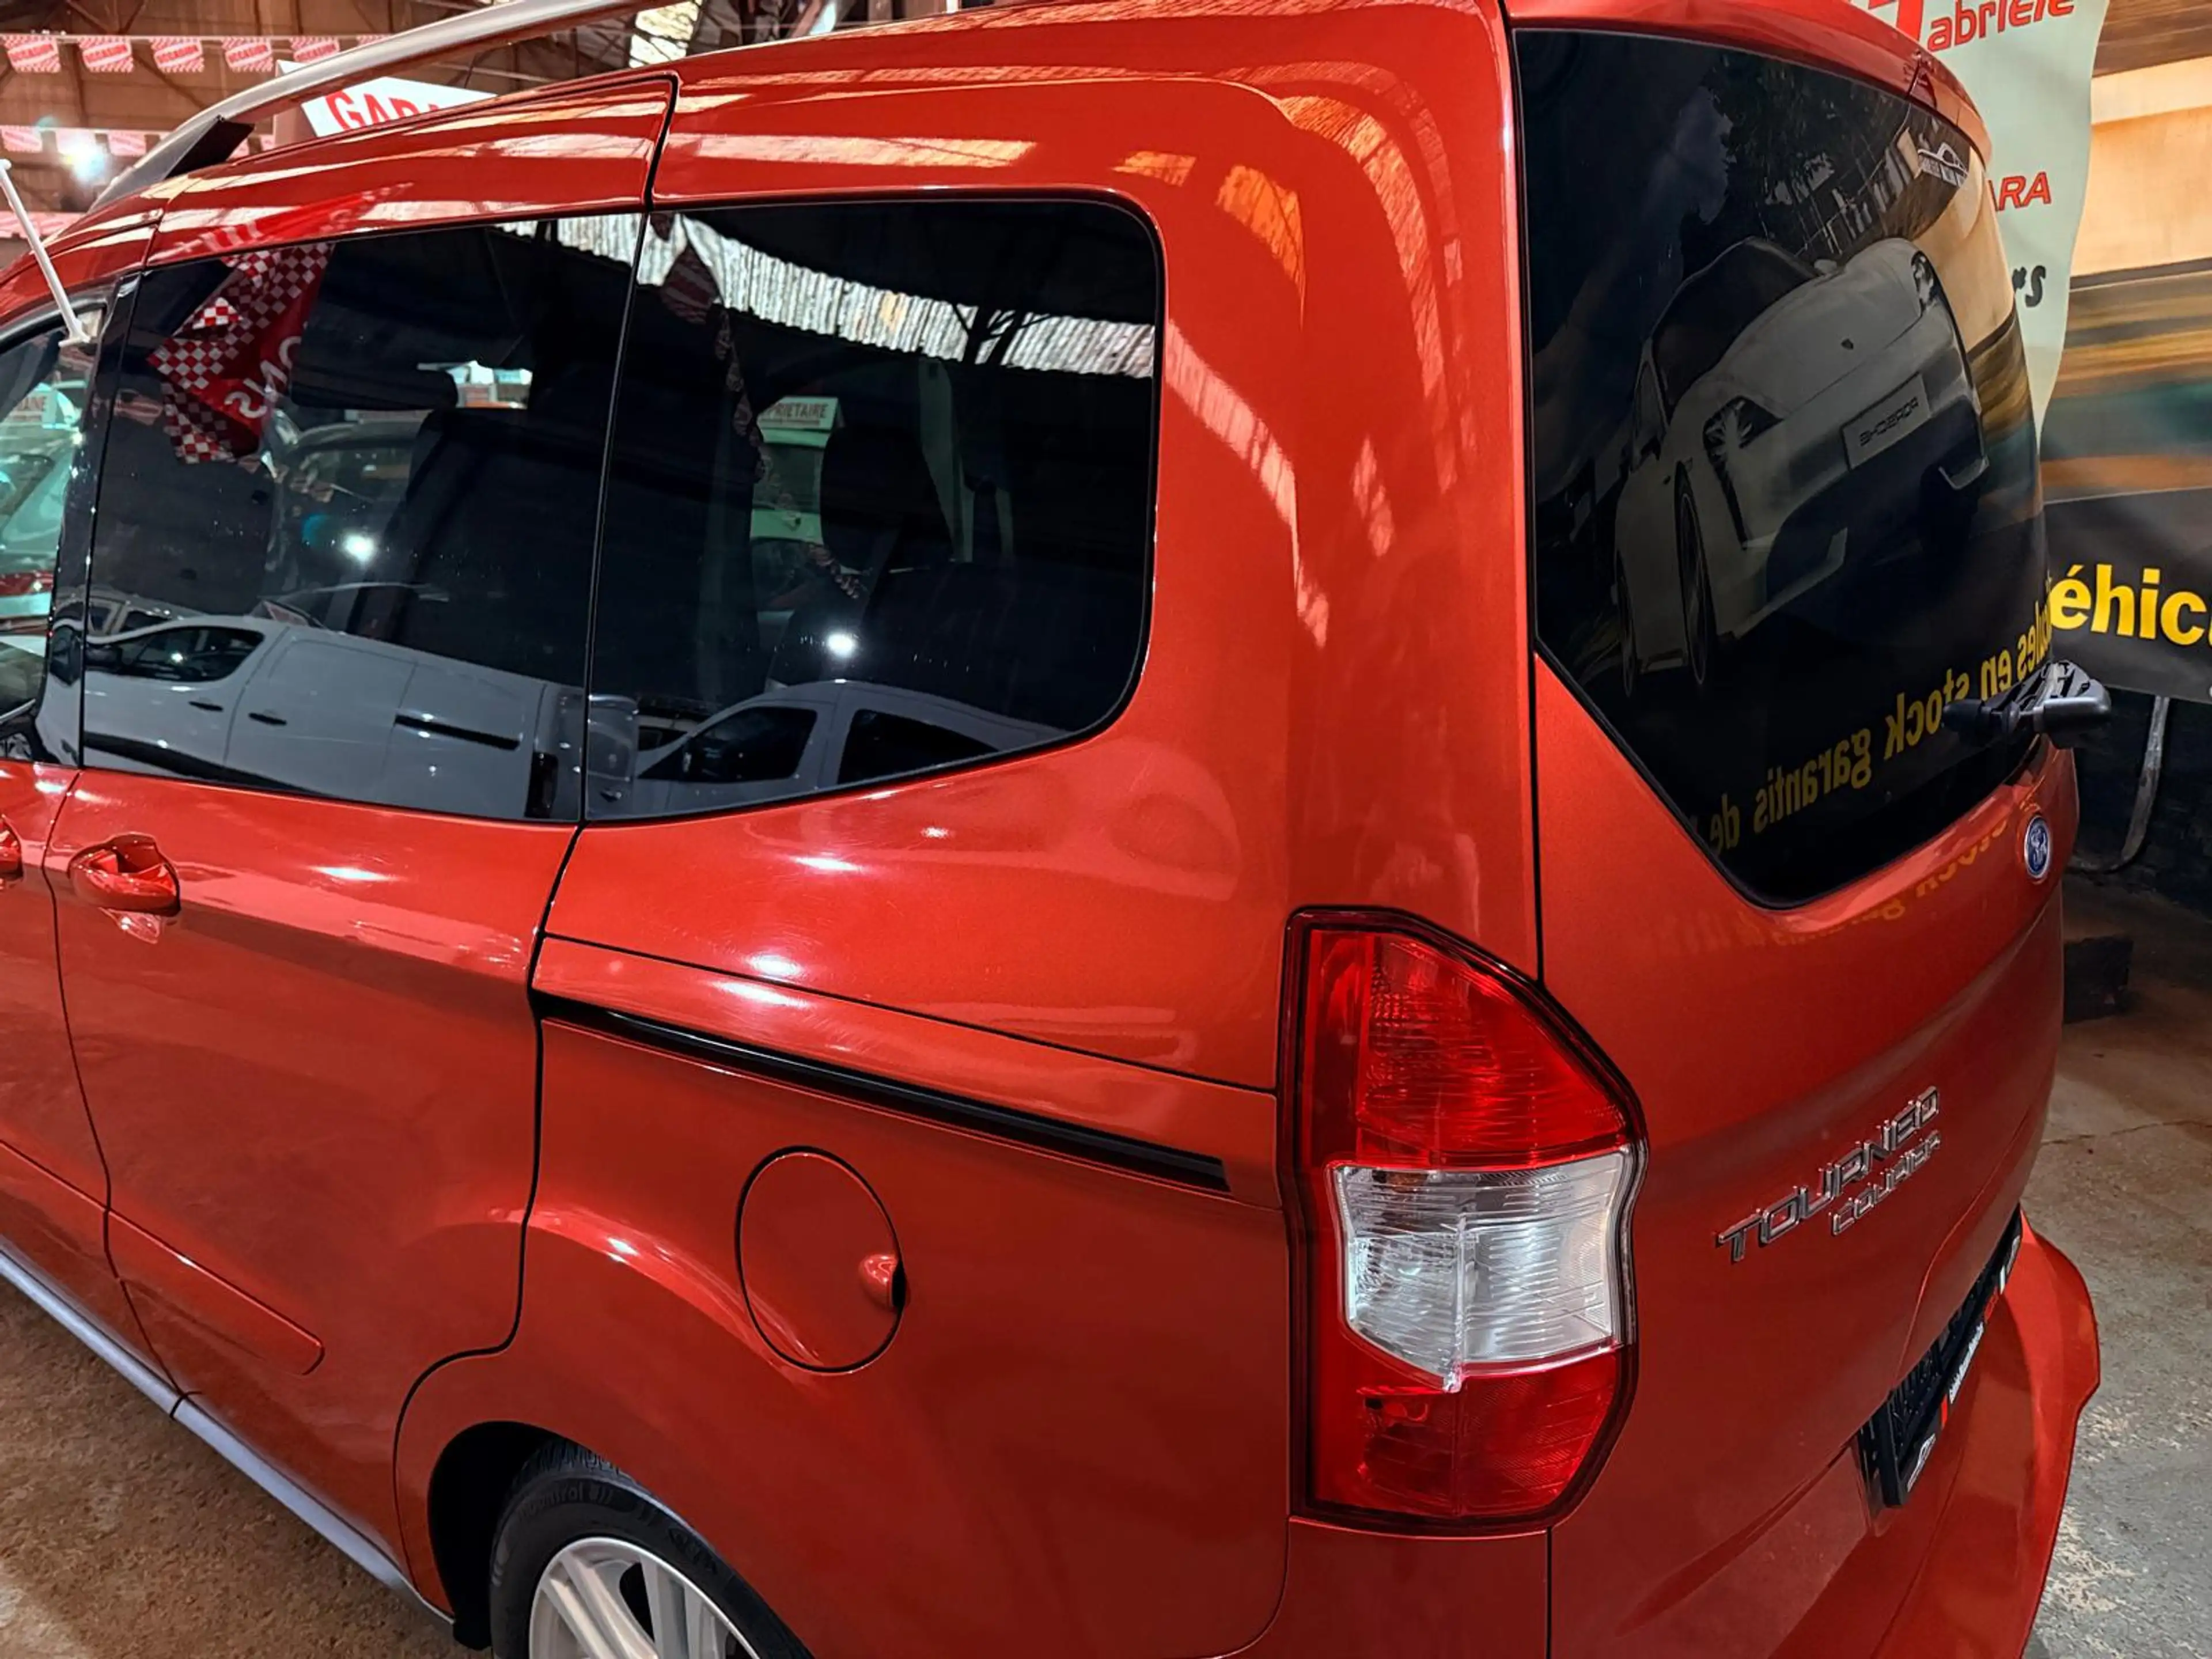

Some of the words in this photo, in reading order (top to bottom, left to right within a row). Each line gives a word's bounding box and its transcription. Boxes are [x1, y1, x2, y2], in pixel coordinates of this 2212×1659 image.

[2050, 564, 2212, 646] éhic
[1718, 1085, 1940, 1262] TOURNEO
[1832, 1130, 1941, 1236] COURIER
